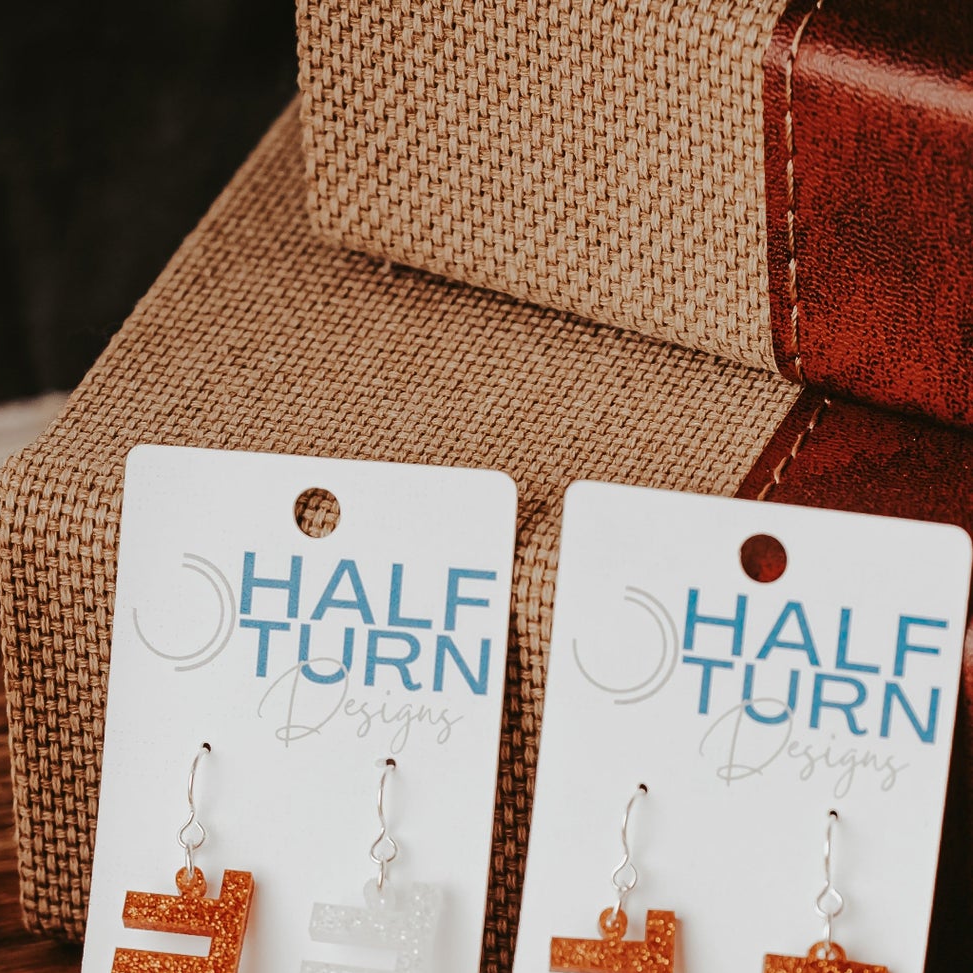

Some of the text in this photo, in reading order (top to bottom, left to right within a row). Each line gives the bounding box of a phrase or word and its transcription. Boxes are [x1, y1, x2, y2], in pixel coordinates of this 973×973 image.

[239, 551, 497, 631] HALF
[683, 588, 949, 677] HALF
[239, 618, 491, 695] TURN
[682, 655, 942, 744] TURN
[257, 657, 464, 753] Designs
[699, 698, 909, 799] Designs
